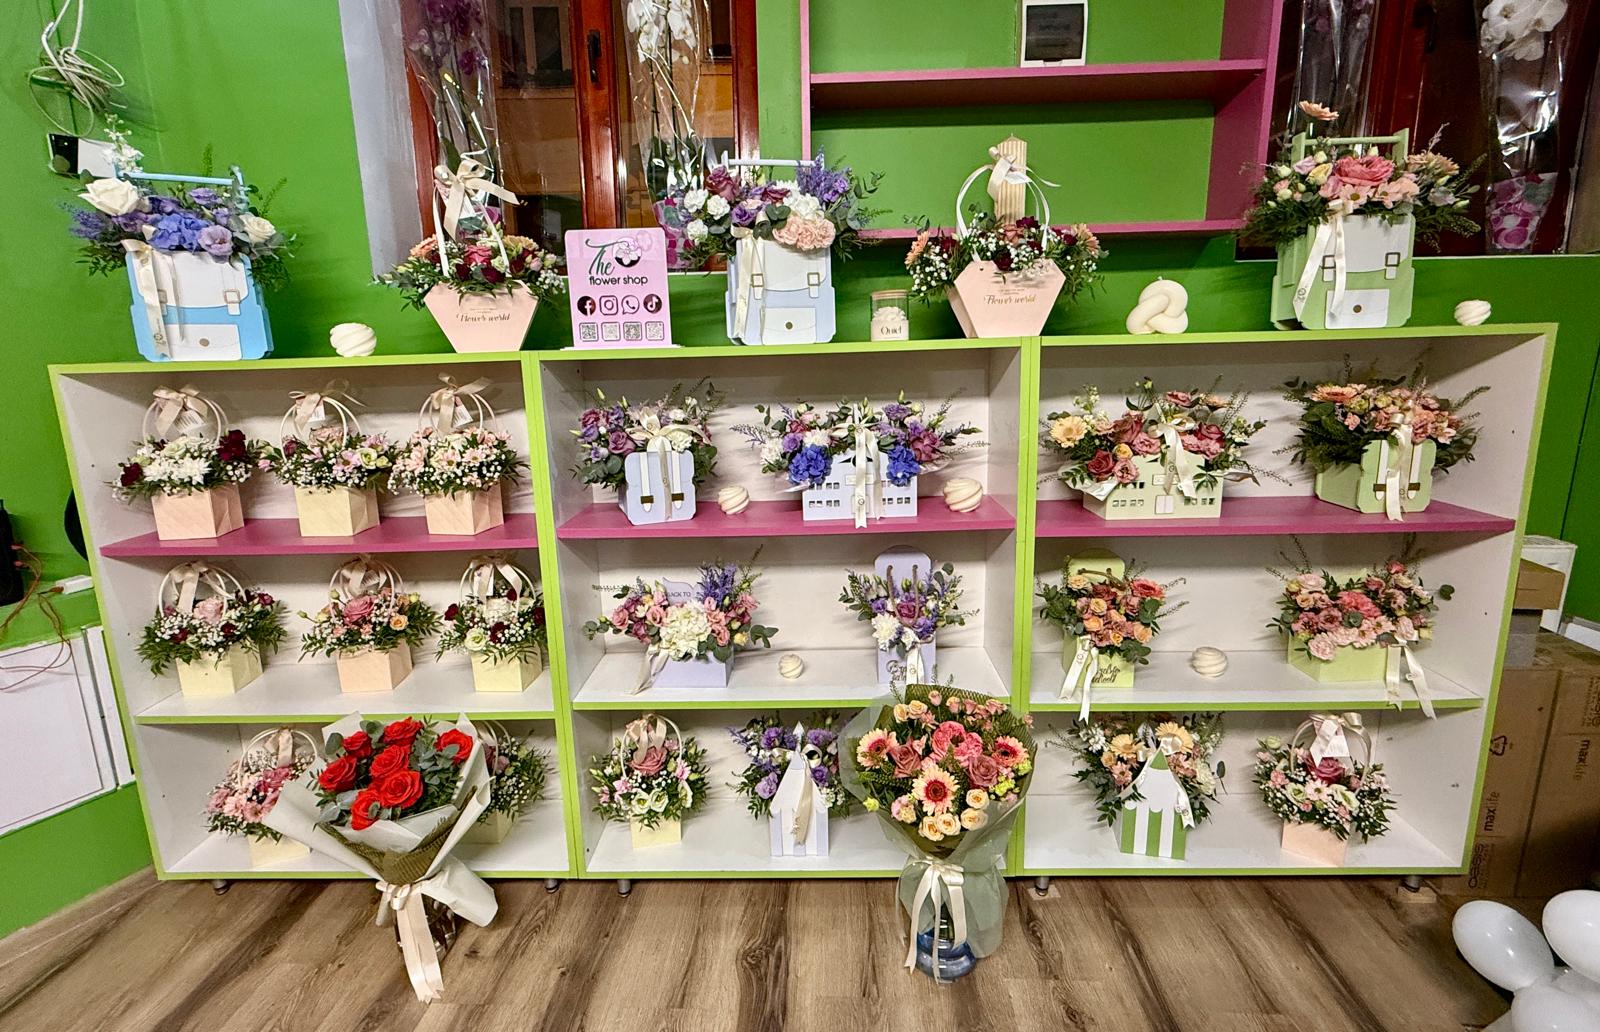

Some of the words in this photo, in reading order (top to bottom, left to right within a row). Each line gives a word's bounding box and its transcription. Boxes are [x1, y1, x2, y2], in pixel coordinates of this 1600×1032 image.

[585, 238, 628, 276] The
[589, 275, 620, 286] flower
[623, 275, 648, 286] shop
